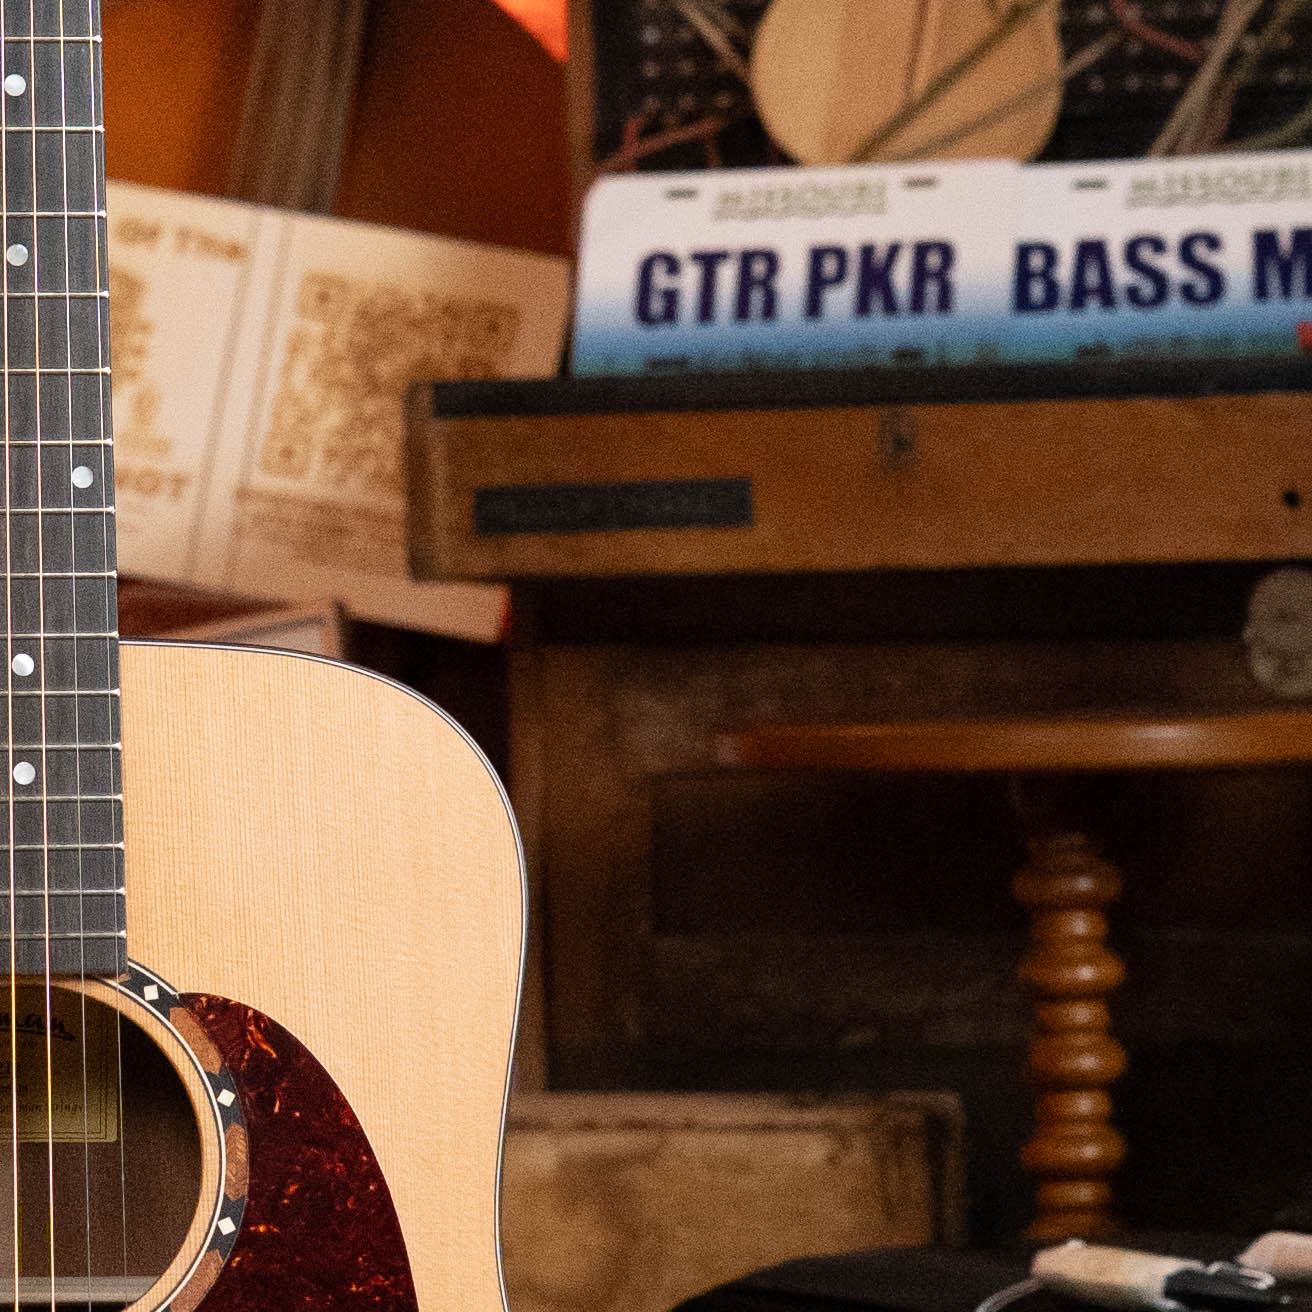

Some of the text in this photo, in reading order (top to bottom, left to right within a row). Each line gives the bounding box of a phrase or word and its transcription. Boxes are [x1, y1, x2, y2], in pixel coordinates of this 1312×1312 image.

[633, 239, 957, 328] GTR PKR
[1012, 231, 1225, 316] BASS
